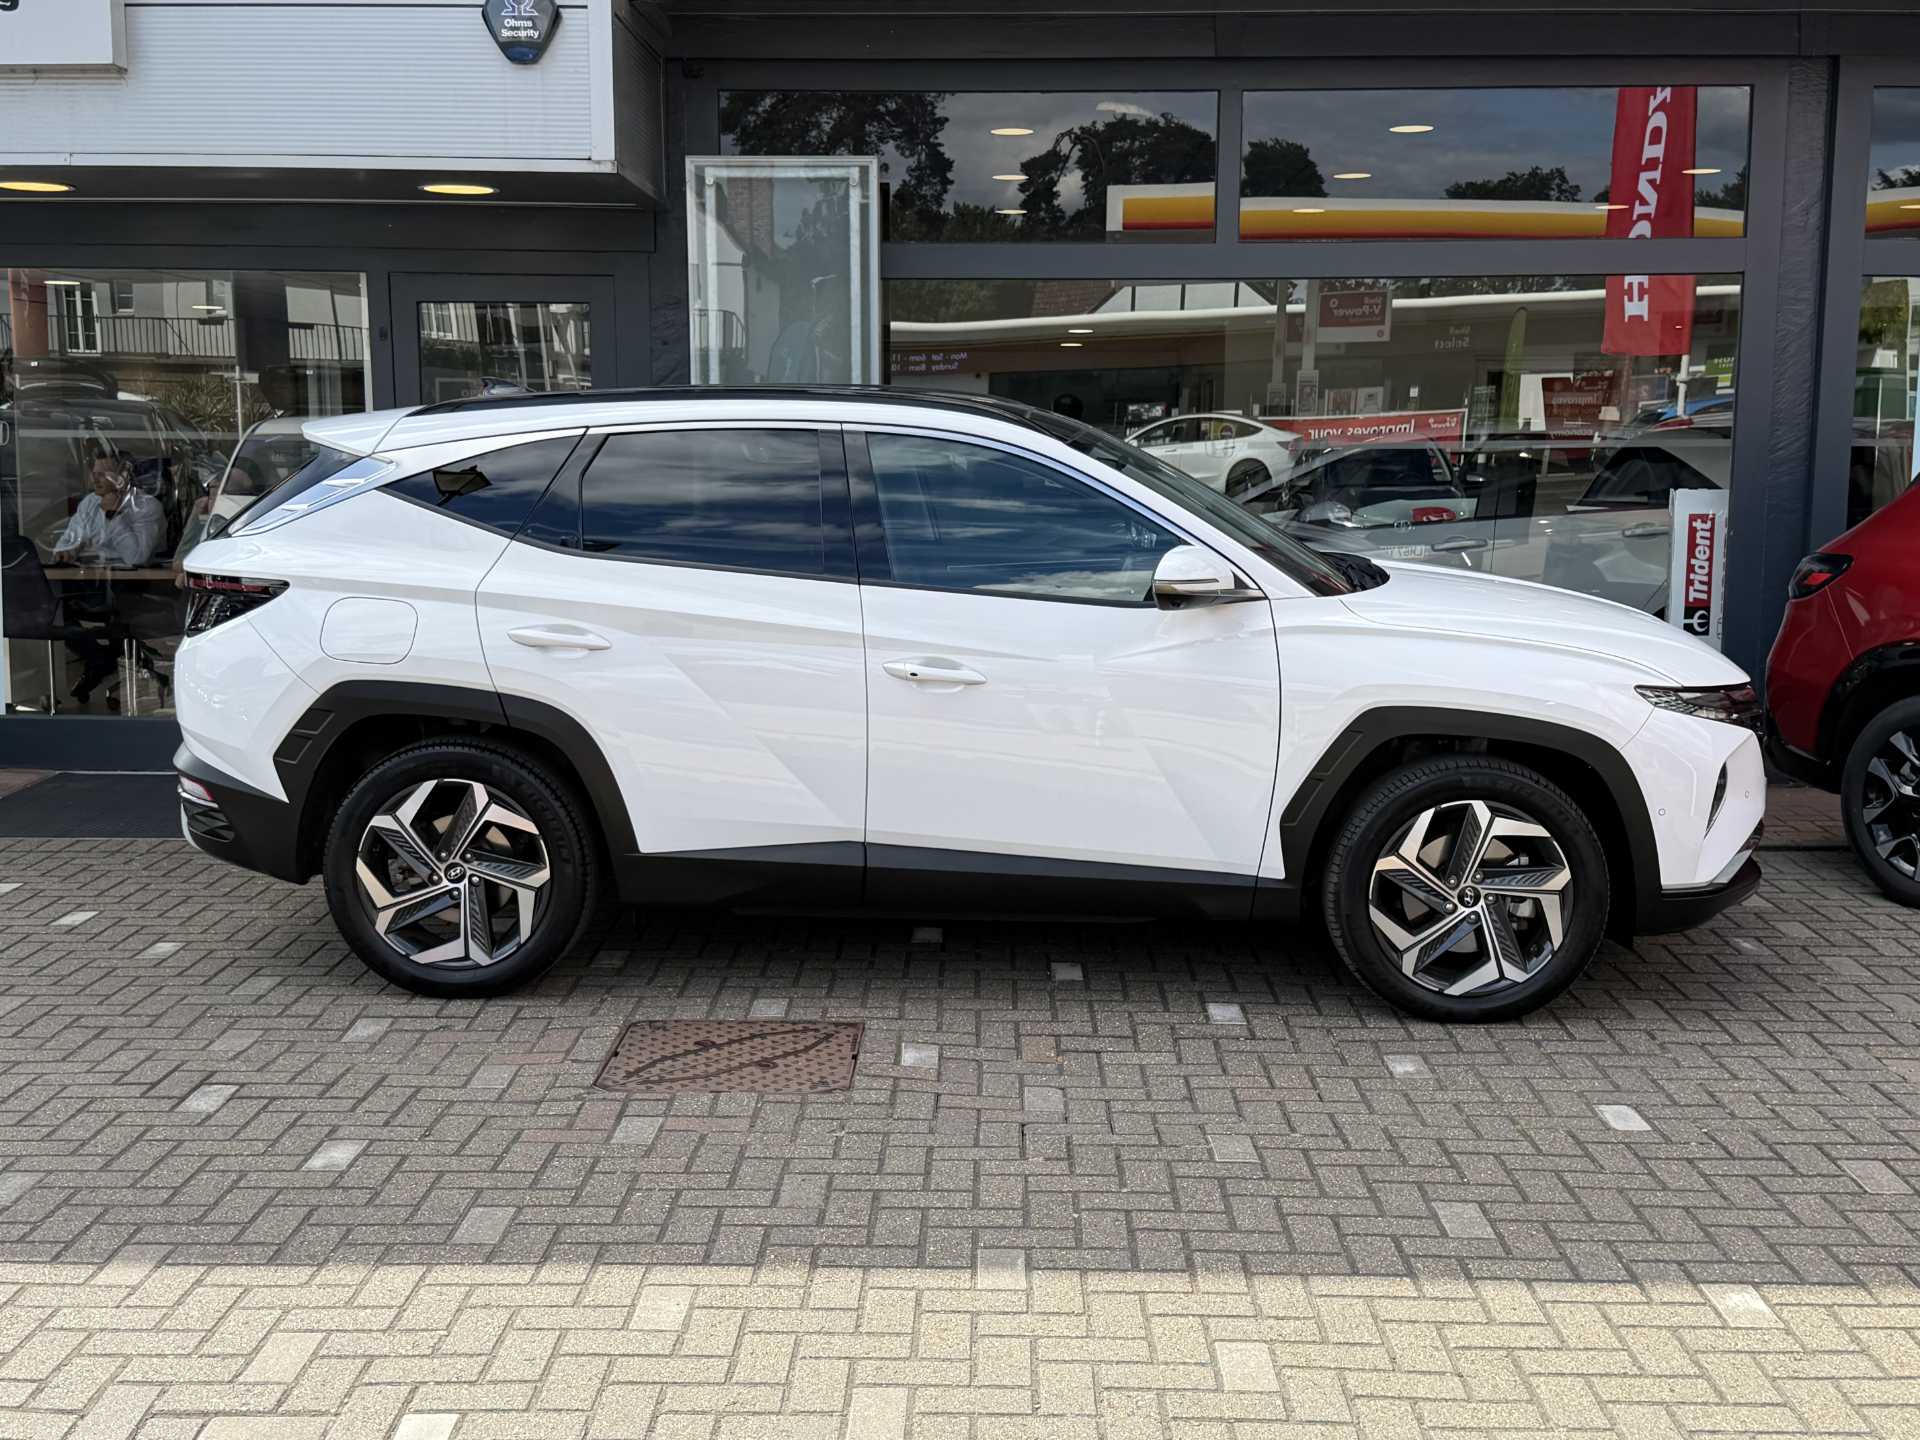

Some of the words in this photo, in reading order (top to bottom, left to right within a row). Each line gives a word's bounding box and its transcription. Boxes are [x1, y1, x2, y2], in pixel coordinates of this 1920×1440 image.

[504, 18, 533, 27] Ohms
[501, 28, 540, 39] Security
[1688, 519, 1712, 602] Trident
